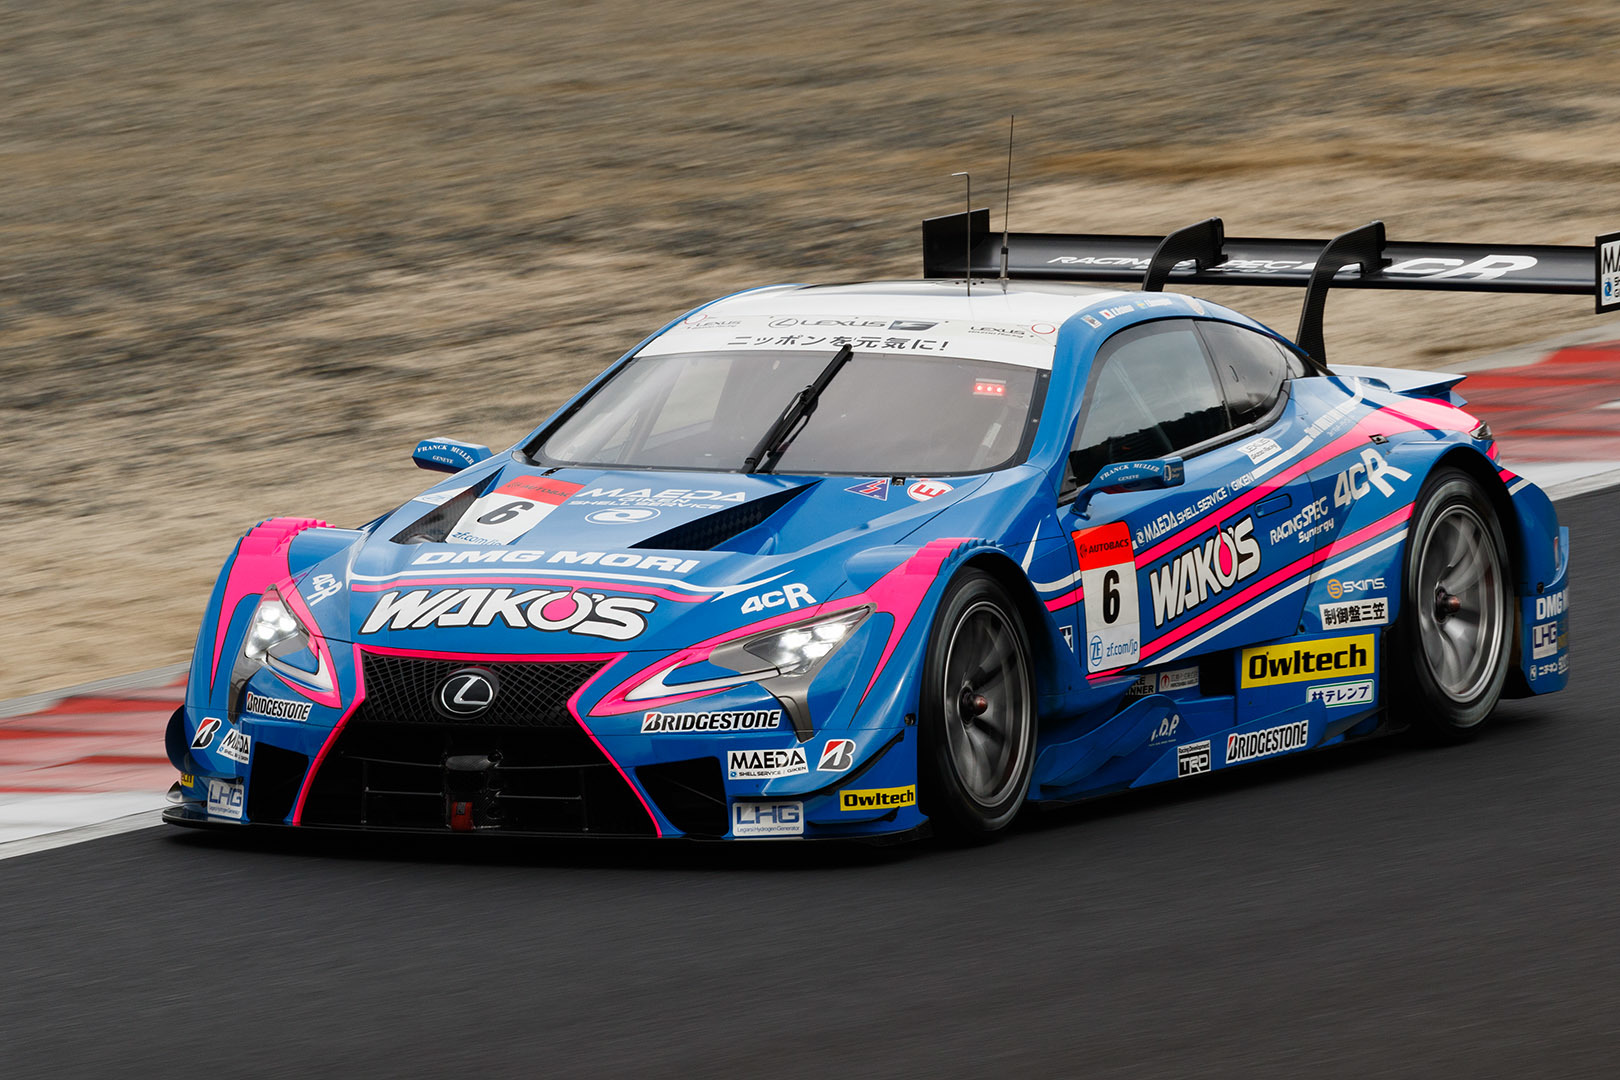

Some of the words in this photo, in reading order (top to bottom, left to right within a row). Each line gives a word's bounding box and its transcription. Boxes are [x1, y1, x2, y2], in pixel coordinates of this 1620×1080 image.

[801, 319, 887, 327] LEXUS
[417, 444, 448, 454] FRANCK
[451, 445, 475, 466] MULLER
[432, 454, 454, 464] GENEVE
[1100, 463, 1129, 481] FRANCK
[1132, 462, 1161, 473] MULLER
[1333, 447, 1413, 509] 4CR
[575, 487, 747, 503] MAEDA
[1143, 510, 1179, 543] MAEDA
[1176, 504, 1200, 525] SHELL
[1196, 486, 1229, 513] SERVICE
[1230, 471, 1255, 492] GIKEN
[476, 501, 535, 525] 6
[1298, 517, 1335, 545] Synergy
[1088, 538, 1129, 554] AUTOBACS
[411, 550, 546, 566] DMG
[546, 550, 701, 573] MORI
[1149, 514, 1261, 629] WAKO'S
[306, 573, 344, 607] 4CR
[740, 582, 818, 615] 4CR
[1102, 569, 1121, 625] 6
[359, 588, 658, 641] WAKO'S
[1323, 601, 1386, 626] 制御盤三笠
[1536, 592, 1562, 620] DMG
[1248, 643, 1367, 680] Owltech
[247, 693, 311, 720] BRIDGESTONE
[642, 710, 781, 732] BRIDGESTONE
[1227, 719, 1309, 763] BRIDGESTONE
[730, 750, 806, 770] MAEDA
[209, 783, 243, 808] LHG
[843, 786, 915, 807] Owltech
[736, 805, 800, 825] LHG
